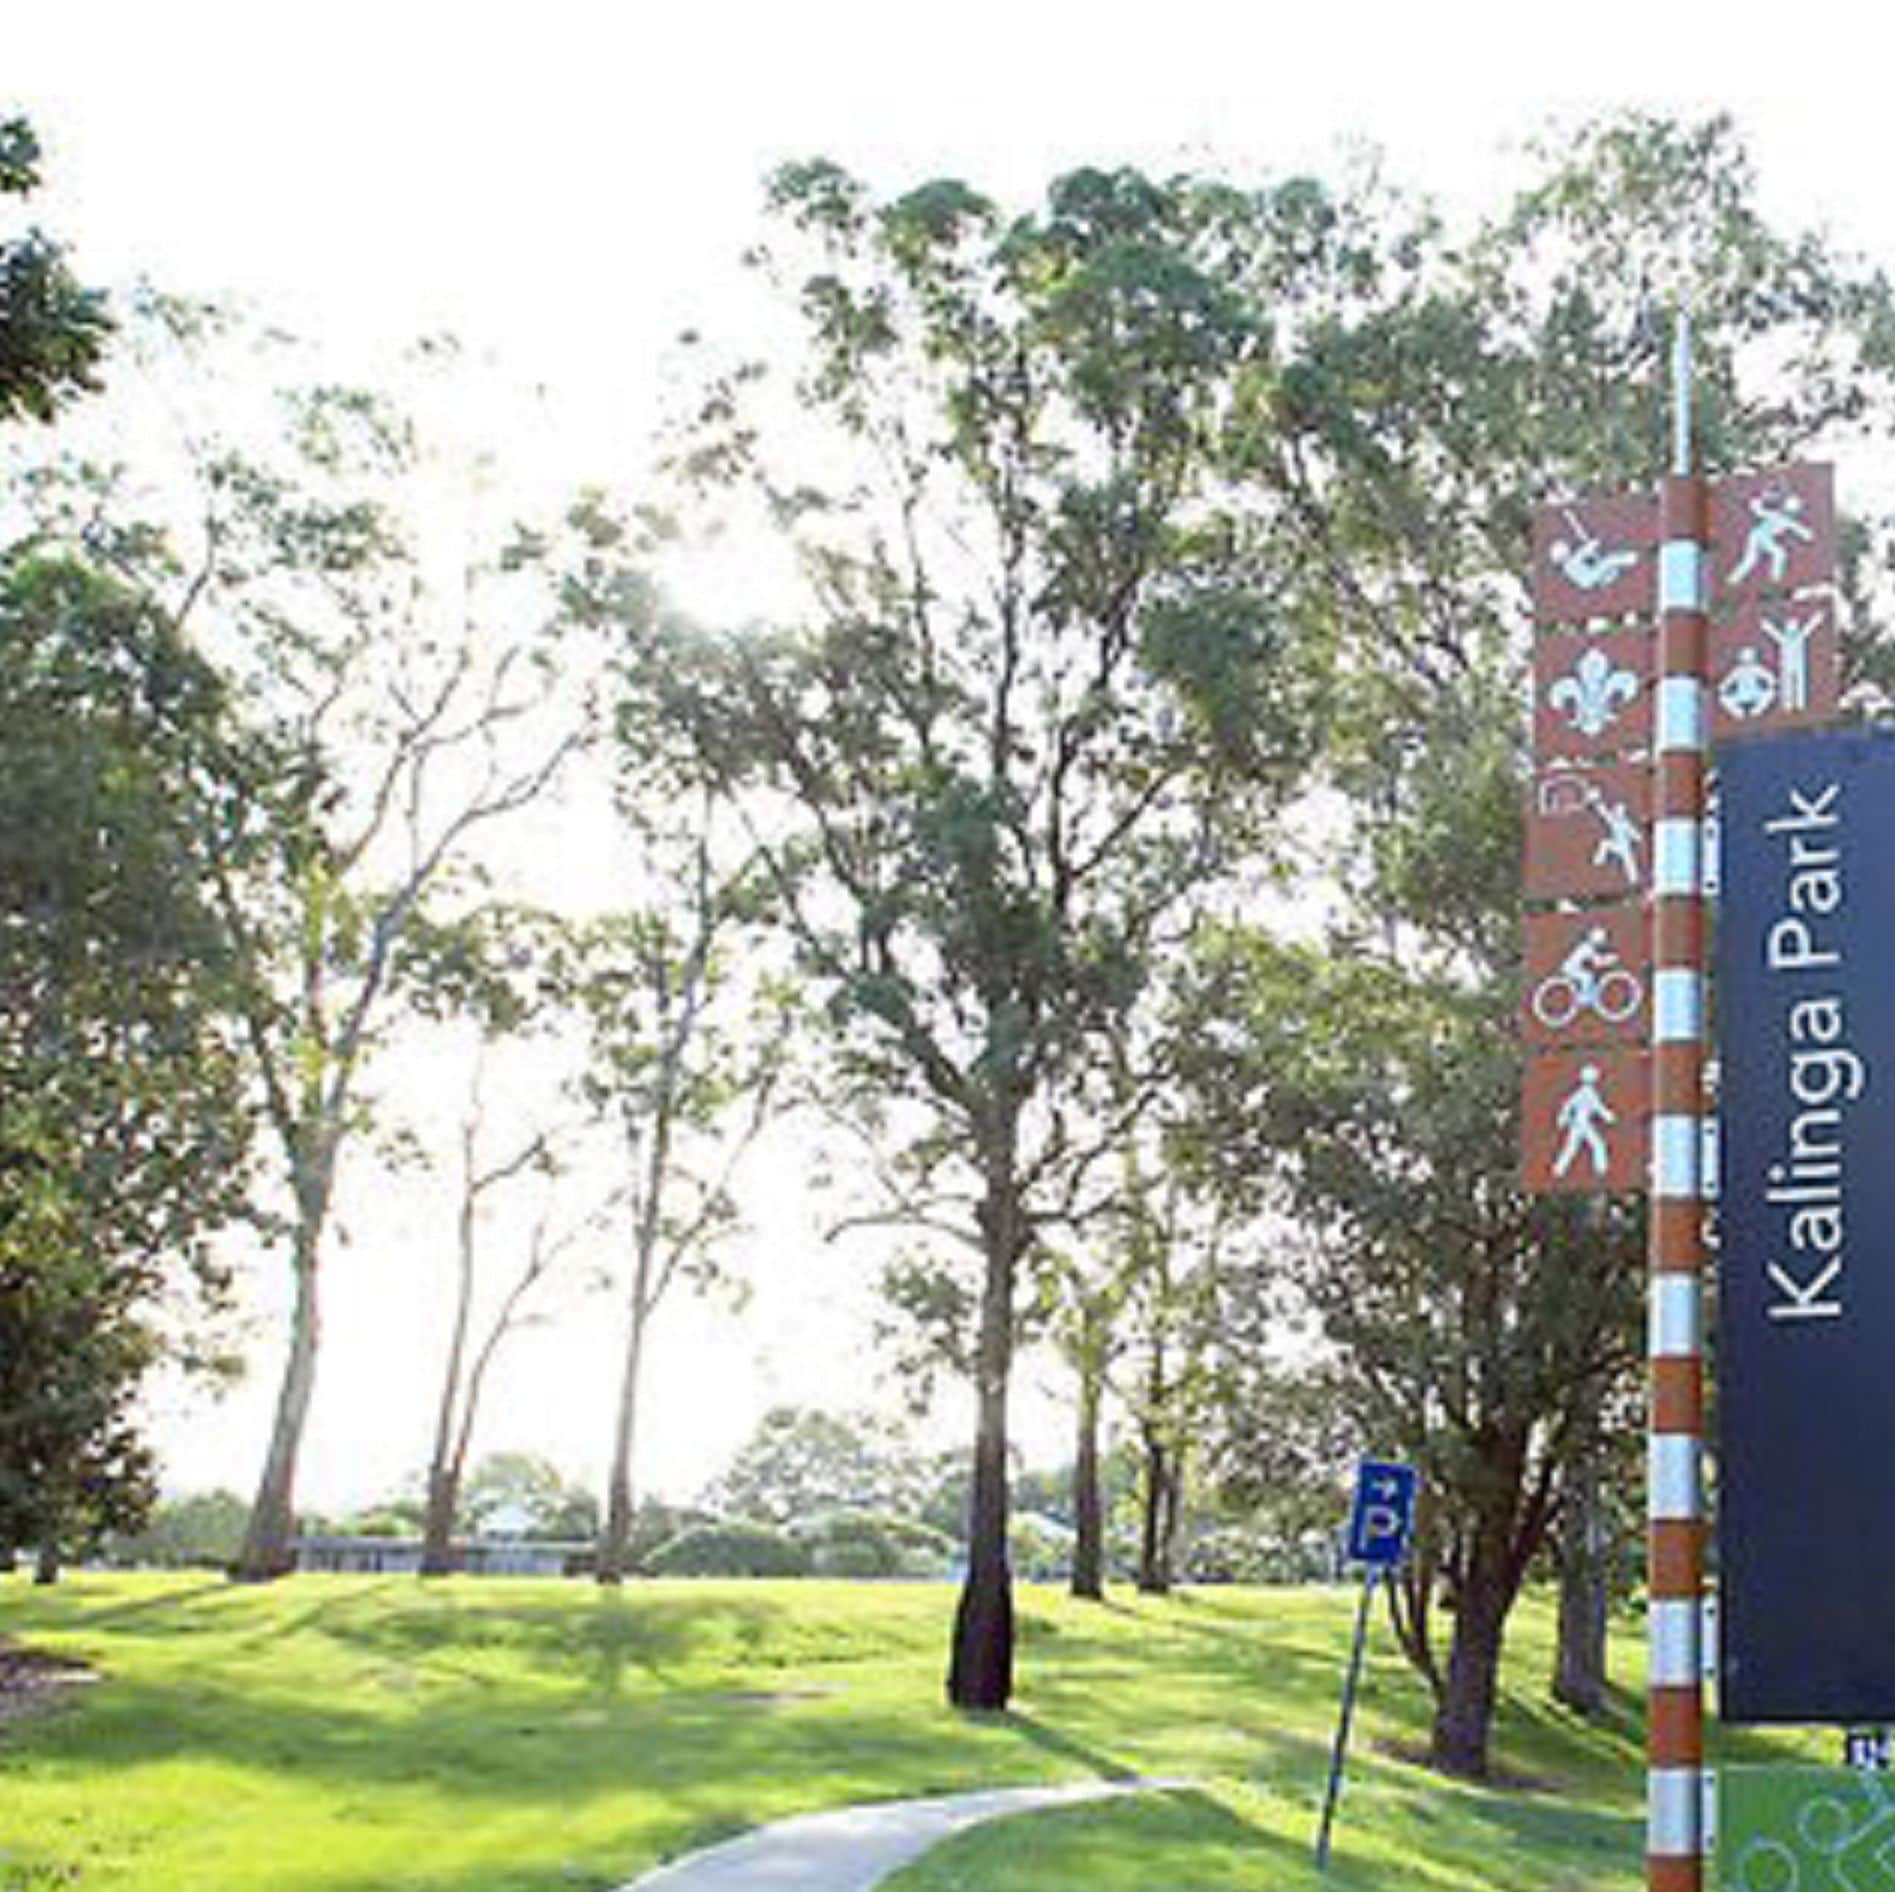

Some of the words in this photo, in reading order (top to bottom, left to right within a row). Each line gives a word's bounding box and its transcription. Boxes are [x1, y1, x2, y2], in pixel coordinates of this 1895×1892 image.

[1765, 783, 1841, 969] Park
[1765, 998, 1867, 1320] Kalinga
[1358, 1505, 1400, 1553] P
